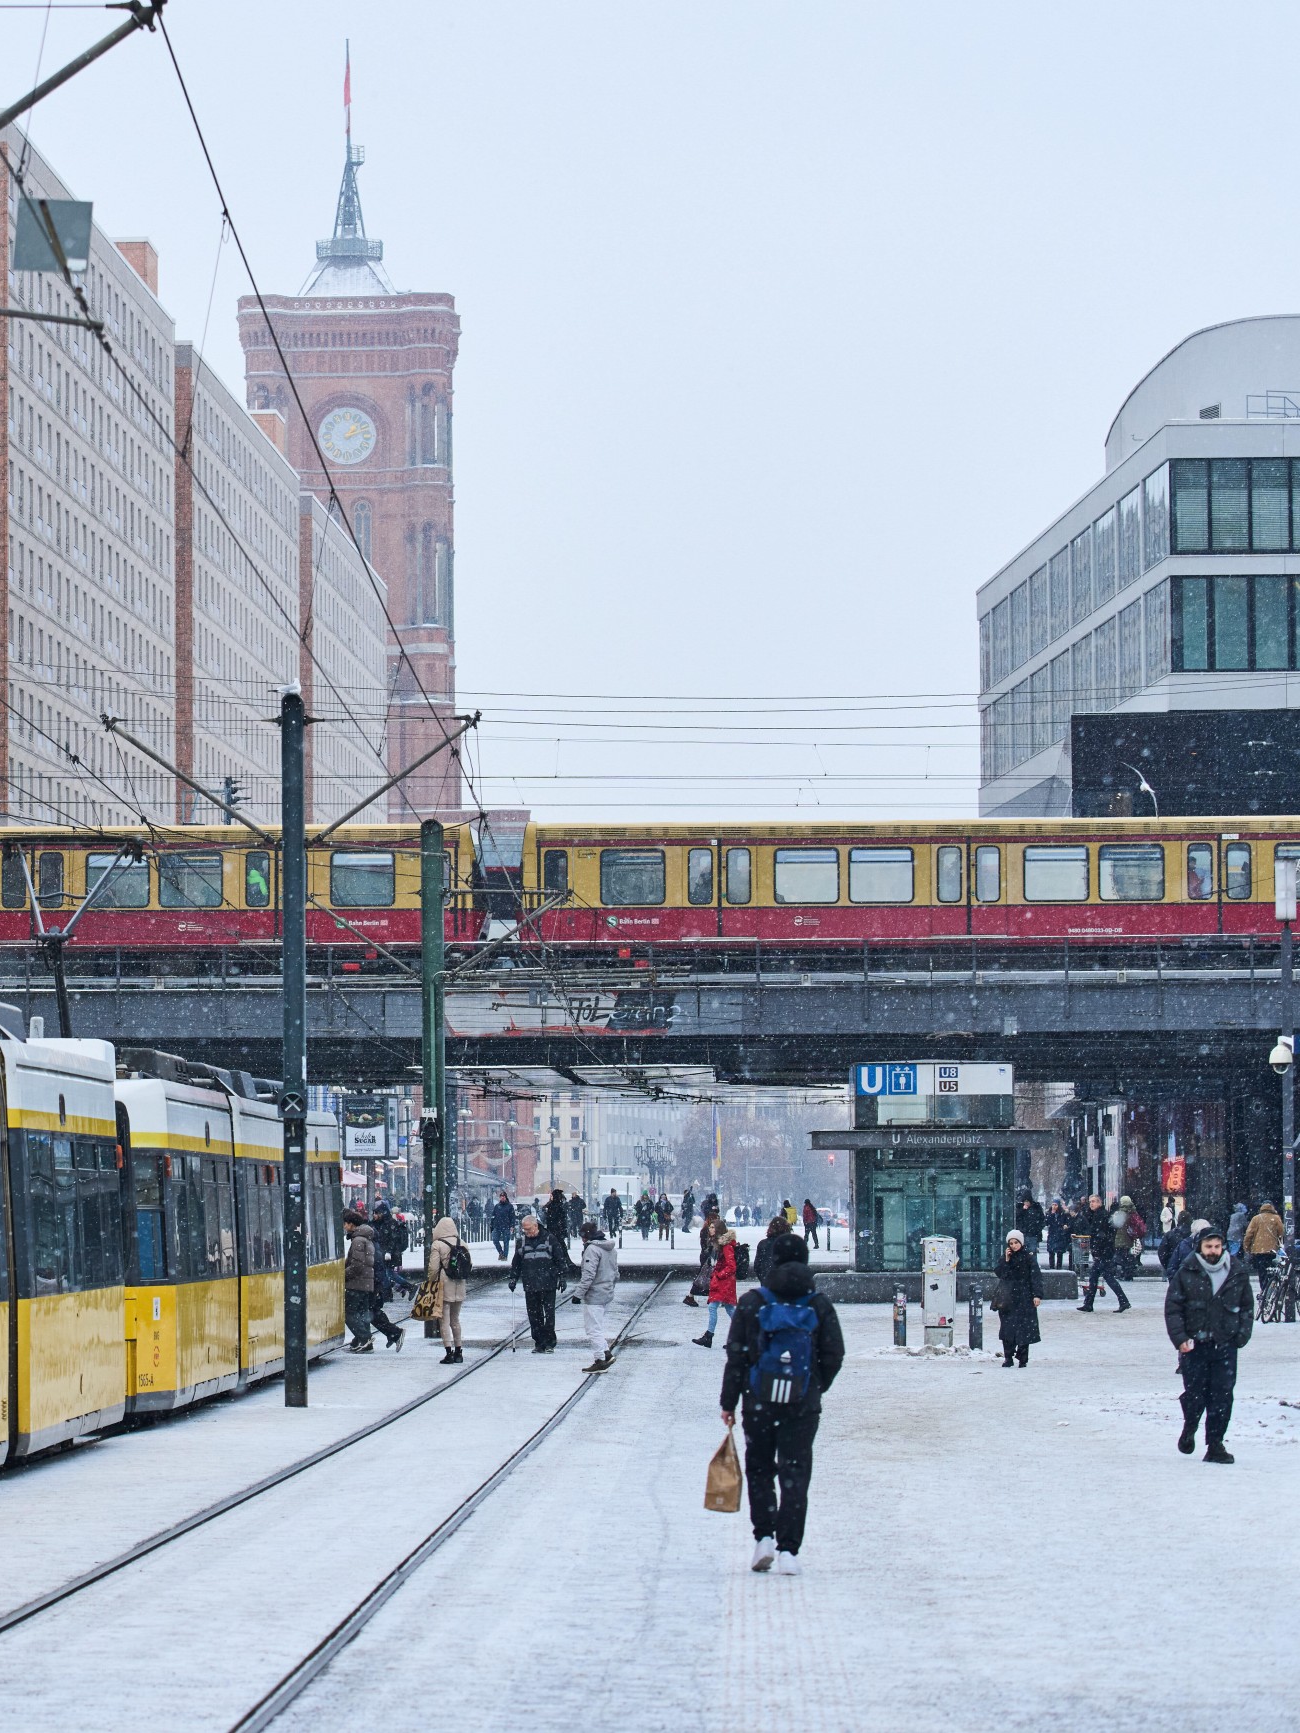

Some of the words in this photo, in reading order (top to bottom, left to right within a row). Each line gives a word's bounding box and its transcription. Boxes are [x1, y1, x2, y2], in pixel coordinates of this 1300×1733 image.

[620, 917, 633, 925] Bahn
[940, 1067, 957, 1078] U8
[861, 1066, 883, 1094] U
[940, 1081, 957, 1092] U5
[892, 1134, 901, 1144] U
[906, 1133, 982, 1146] Alexanderplatz
